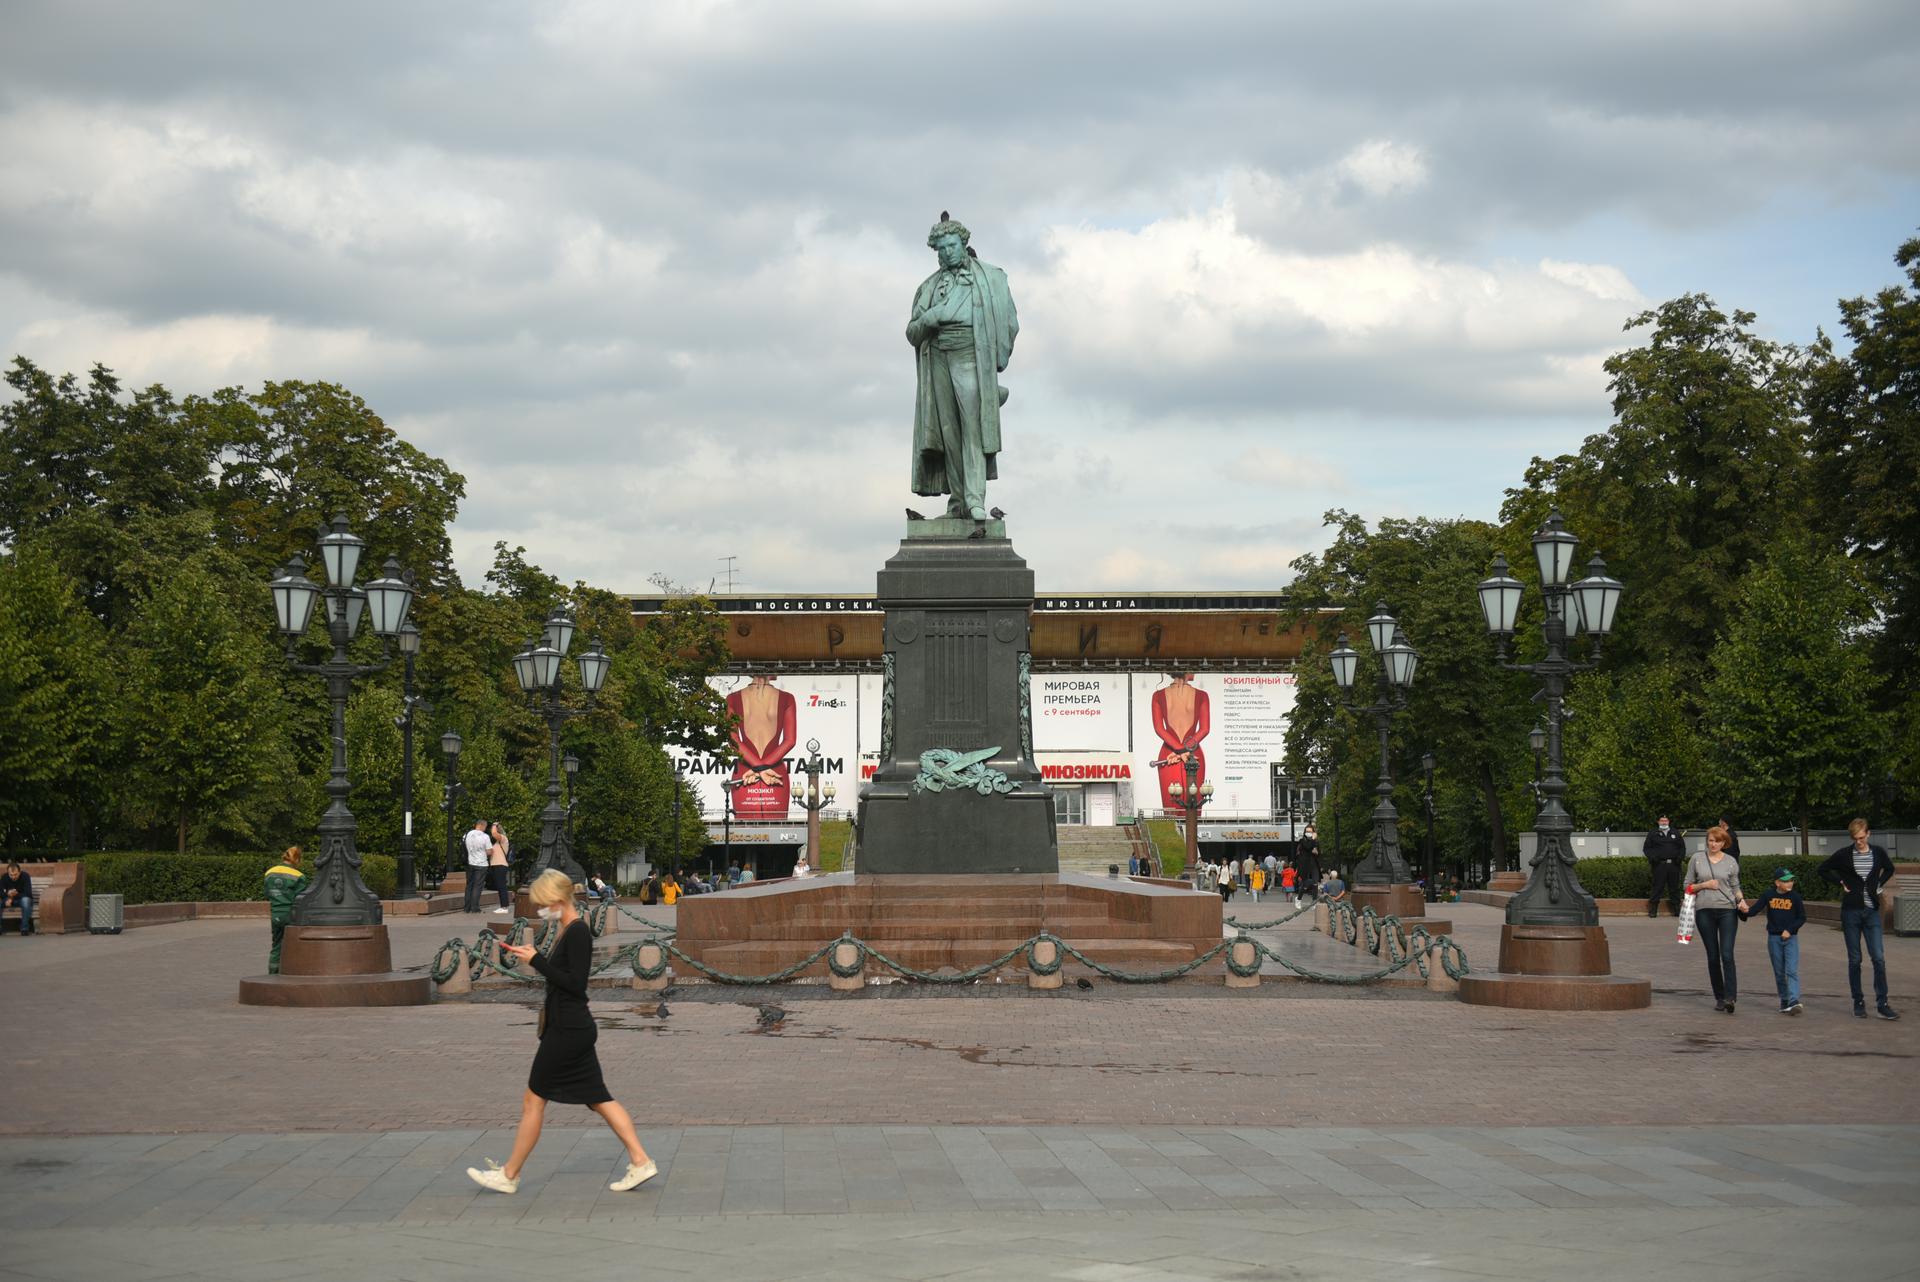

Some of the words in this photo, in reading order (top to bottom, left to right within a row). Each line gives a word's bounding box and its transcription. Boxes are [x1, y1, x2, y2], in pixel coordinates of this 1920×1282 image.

[755, 601, 873, 610] МОСКОВСКИ
[1046, 600, 1136, 608] МЮЗИКЛА
[1223, 676, 1281, 685] ЮБИЛЕЙНЫЙ
[1044, 681, 1100, 691] МИРОВАЯ
[1044, 695, 1101, 704] ПРЕМЬЕРА
[1051, 708, 1057, 716] 9
[1059, 708, 1101, 717] сентября
[1041, 764, 1132, 779] МЮЗИКЛА
